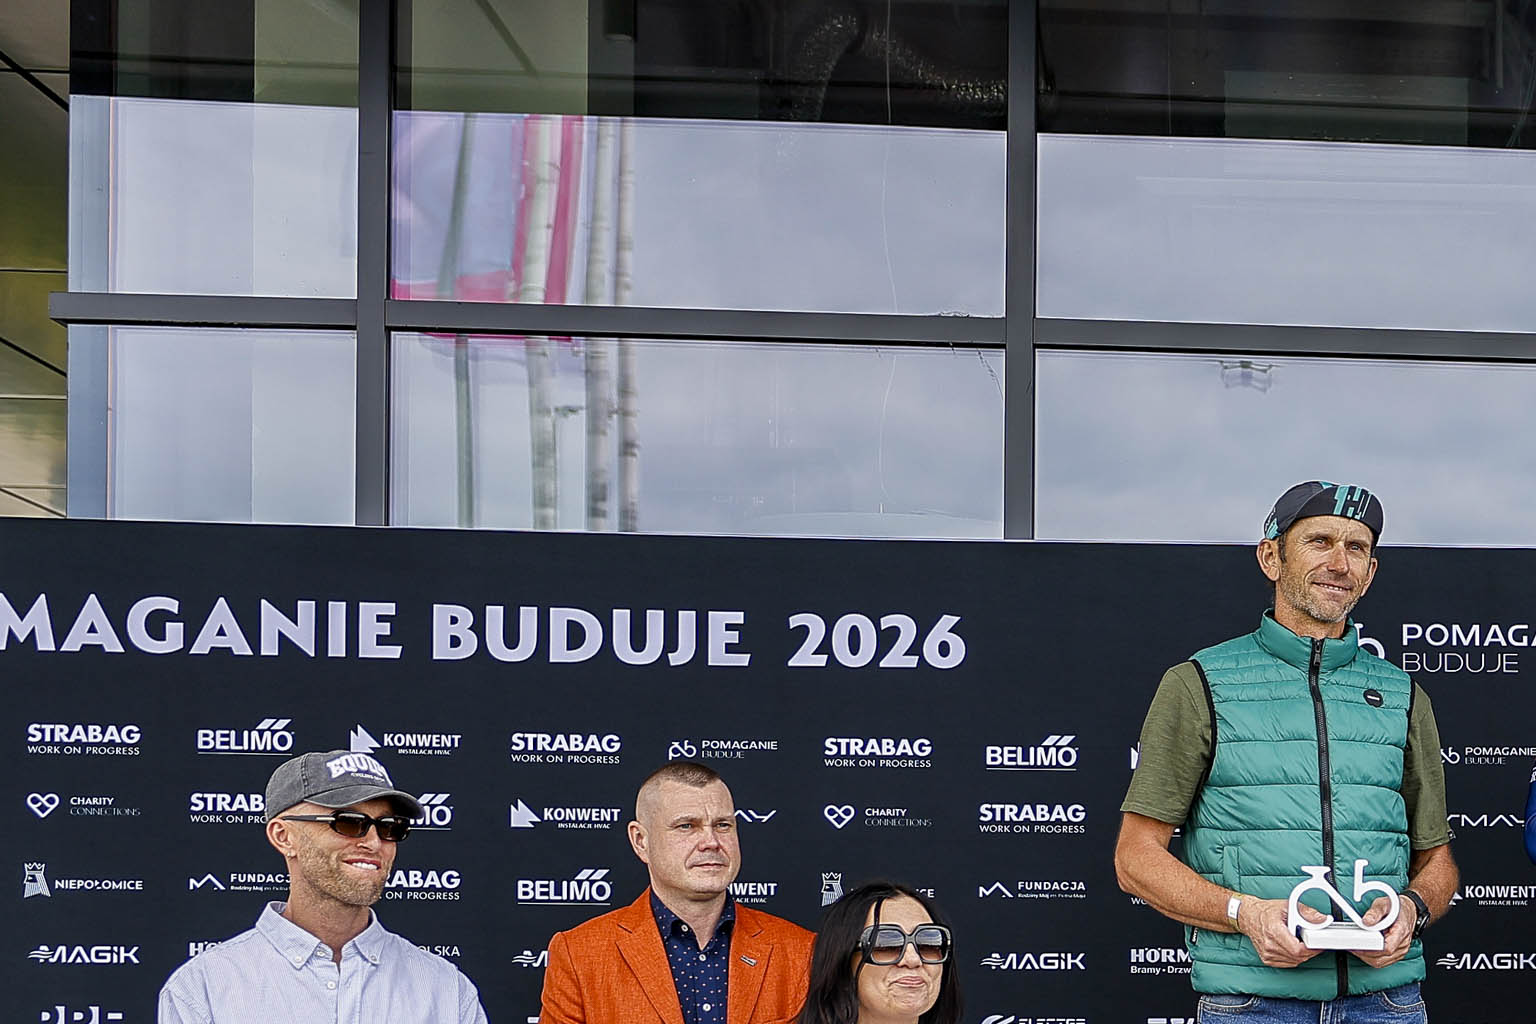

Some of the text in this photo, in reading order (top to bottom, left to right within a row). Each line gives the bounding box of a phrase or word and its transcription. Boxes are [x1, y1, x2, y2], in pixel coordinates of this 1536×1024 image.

[0, 592, 966, 669] MAGANIE BUDUJE 2026
[1402, 652, 1519, 674] BUDUJE
[27, 723, 141, 744] STRABAG
[197, 728, 294, 752] BELIMO
[383, 733, 462, 748] KONWENT
[511, 732, 621, 753] STRABAG
[701, 740, 778, 750] POMAGANIE
[824, 737, 932, 757] STRABAG
[27, 745, 140, 756] WORK ON PROGRESS
[985, 746, 1078, 767] BELIMO
[510, 753, 620, 764] WORK ON PROGRESS
[824, 758, 932, 768] WORK ON PROGRESS
[69, 796, 115, 806] CHARITY
[190, 792, 263, 812] STRAB
[190, 814, 244, 824] WORK ON
[543, 807, 621, 822] KONWENT
[864, 807, 907, 817] CHARITY
[979, 803, 1086, 823] STRABAG
[979, 824, 1086, 834] WORK ON PROGRESS
[230, 873, 291, 884] FUNDACJ
[384, 871, 461, 888] RABAG
[1017, 881, 1086, 891] FUNDACJA
[407, 891, 460, 900] PROGRESS
[517, 880, 609, 901] BELIMO
[1130, 965, 1160, 975] Bramy
